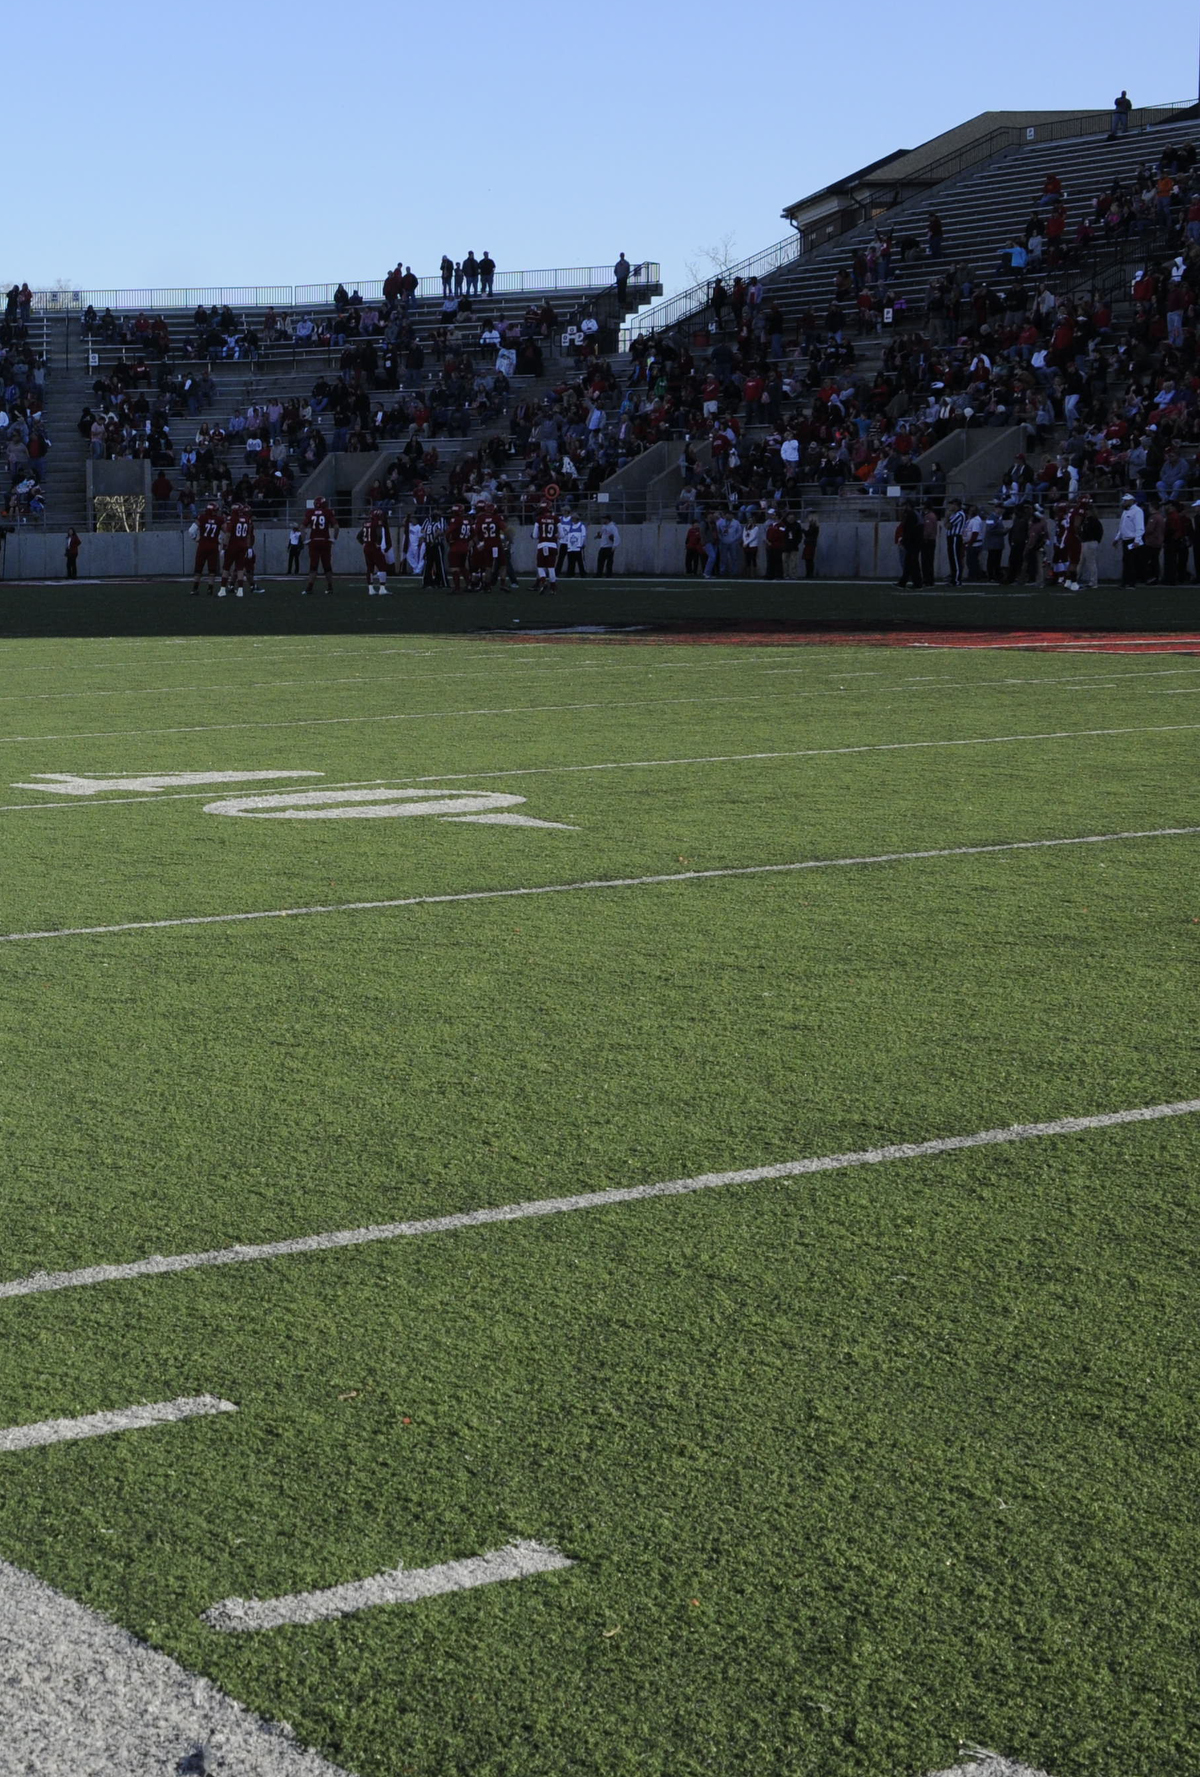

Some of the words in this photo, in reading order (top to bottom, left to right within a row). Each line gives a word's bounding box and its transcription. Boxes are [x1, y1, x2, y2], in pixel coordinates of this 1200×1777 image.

[311, 516, 326, 529] 79
[204, 523, 217, 538] 77
[235, 523, 248, 537] 80
[481, 523, 496, 538] 52
[541, 524, 555, 538] 19
